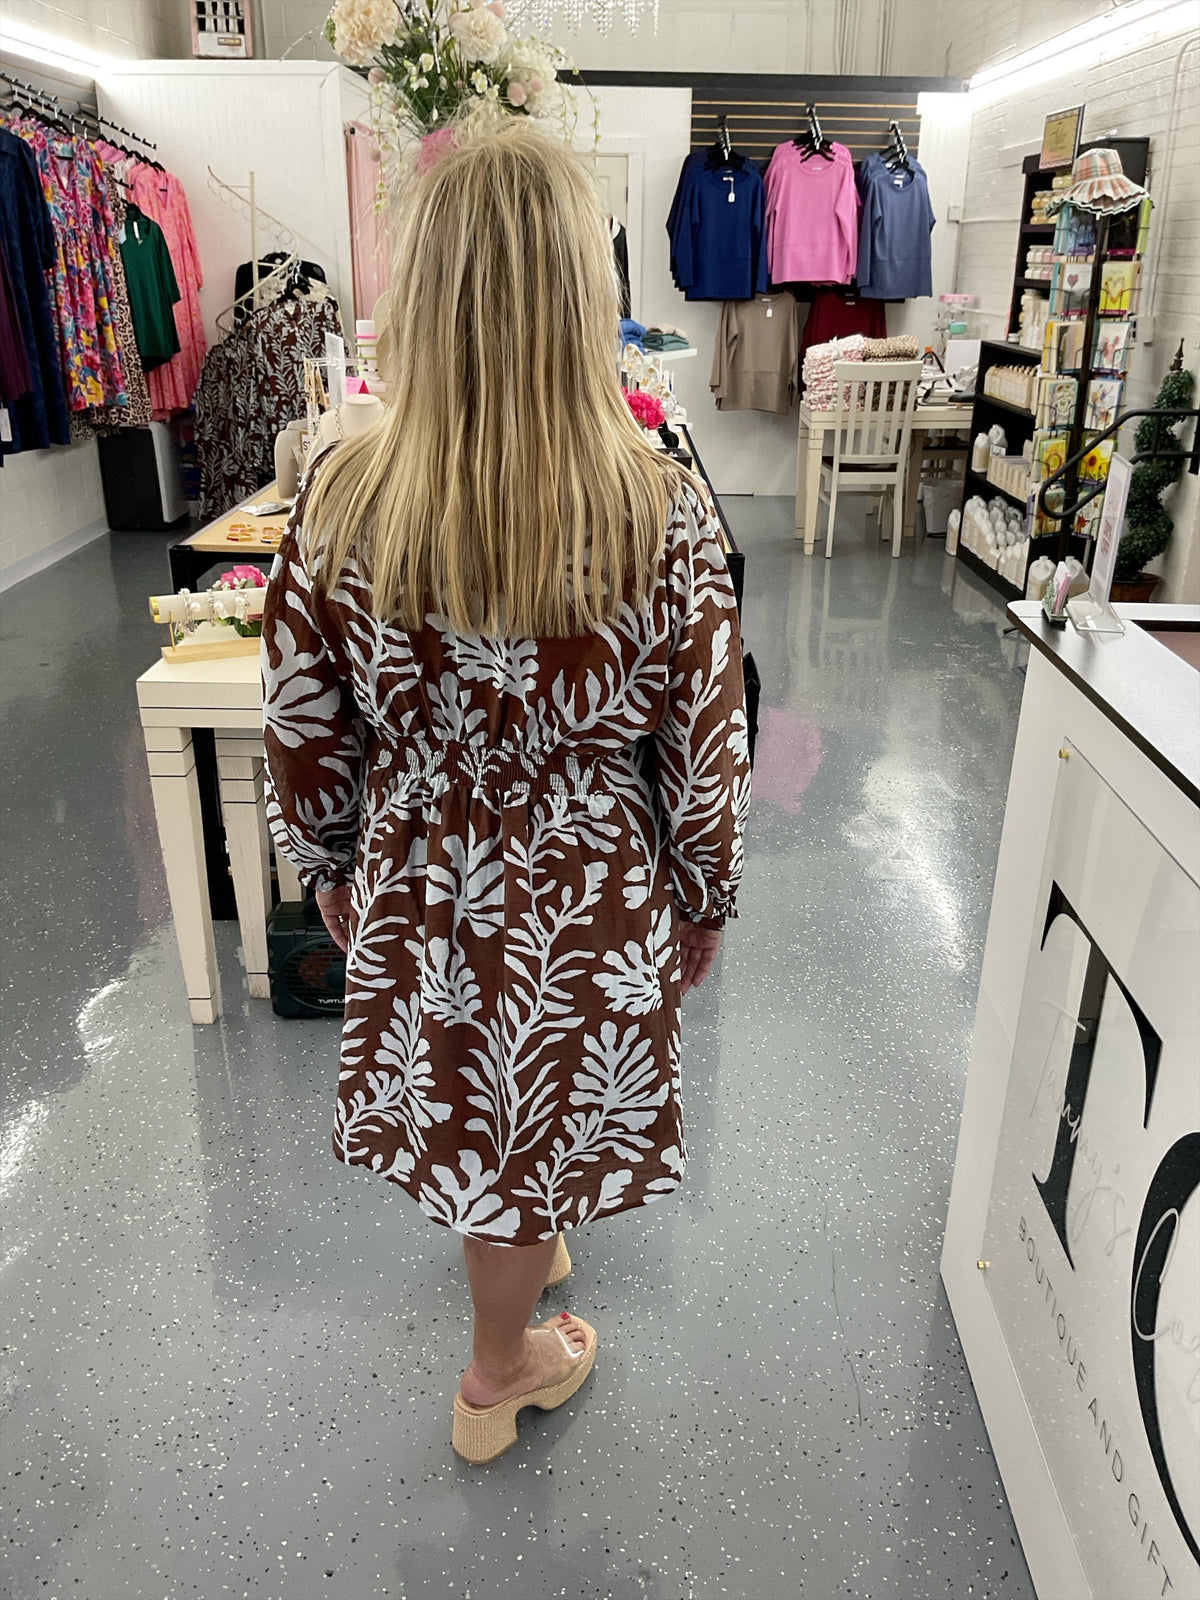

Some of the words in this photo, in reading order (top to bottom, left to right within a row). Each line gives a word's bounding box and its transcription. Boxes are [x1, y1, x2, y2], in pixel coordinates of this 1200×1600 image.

[1018, 1215, 1087, 1393] BOUTIQUE
[1087, 1397, 1124, 1483] AND
[1128, 1492, 1174, 1597] GIFT
